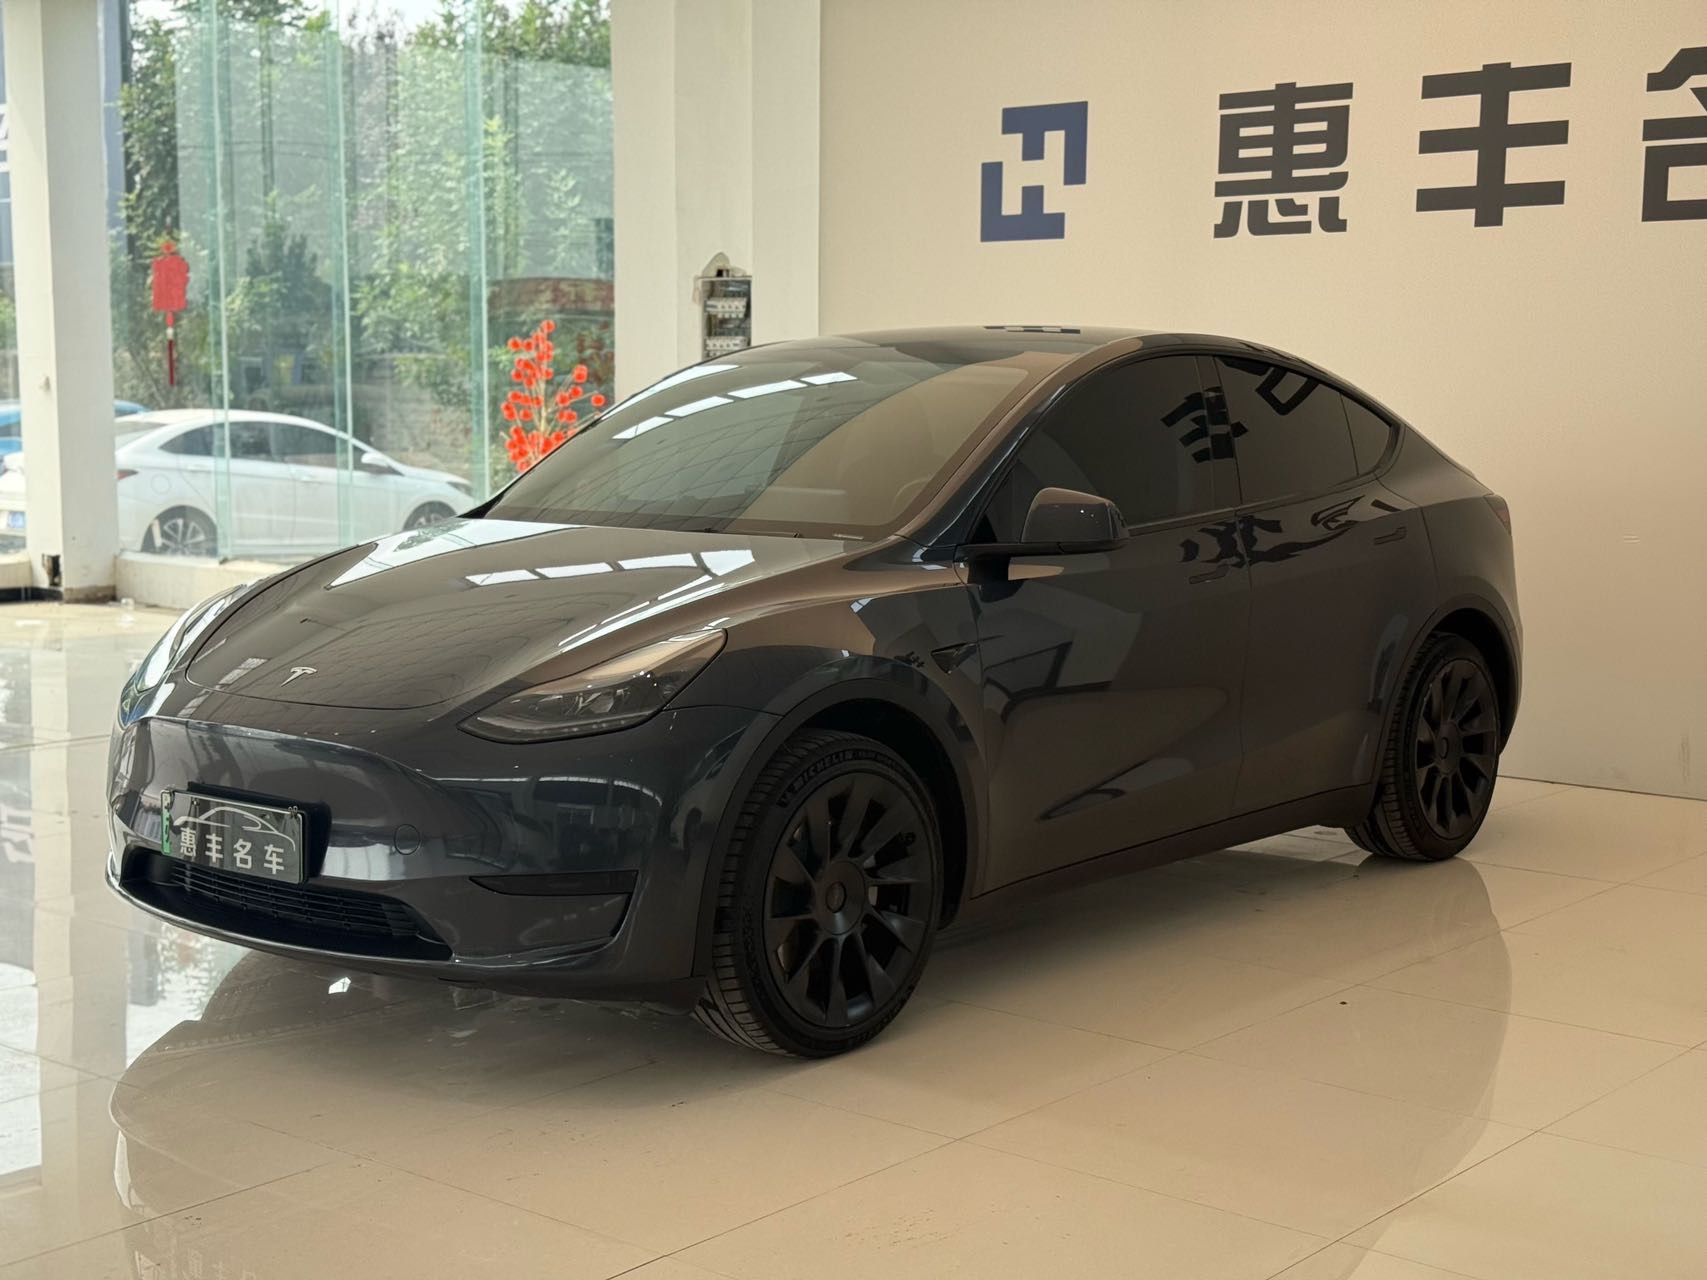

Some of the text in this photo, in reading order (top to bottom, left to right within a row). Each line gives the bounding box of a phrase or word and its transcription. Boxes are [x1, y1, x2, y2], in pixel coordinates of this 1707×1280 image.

[792, 750, 853, 794] MICHELIN
[179, 826, 285, 875] 惠丰名车
